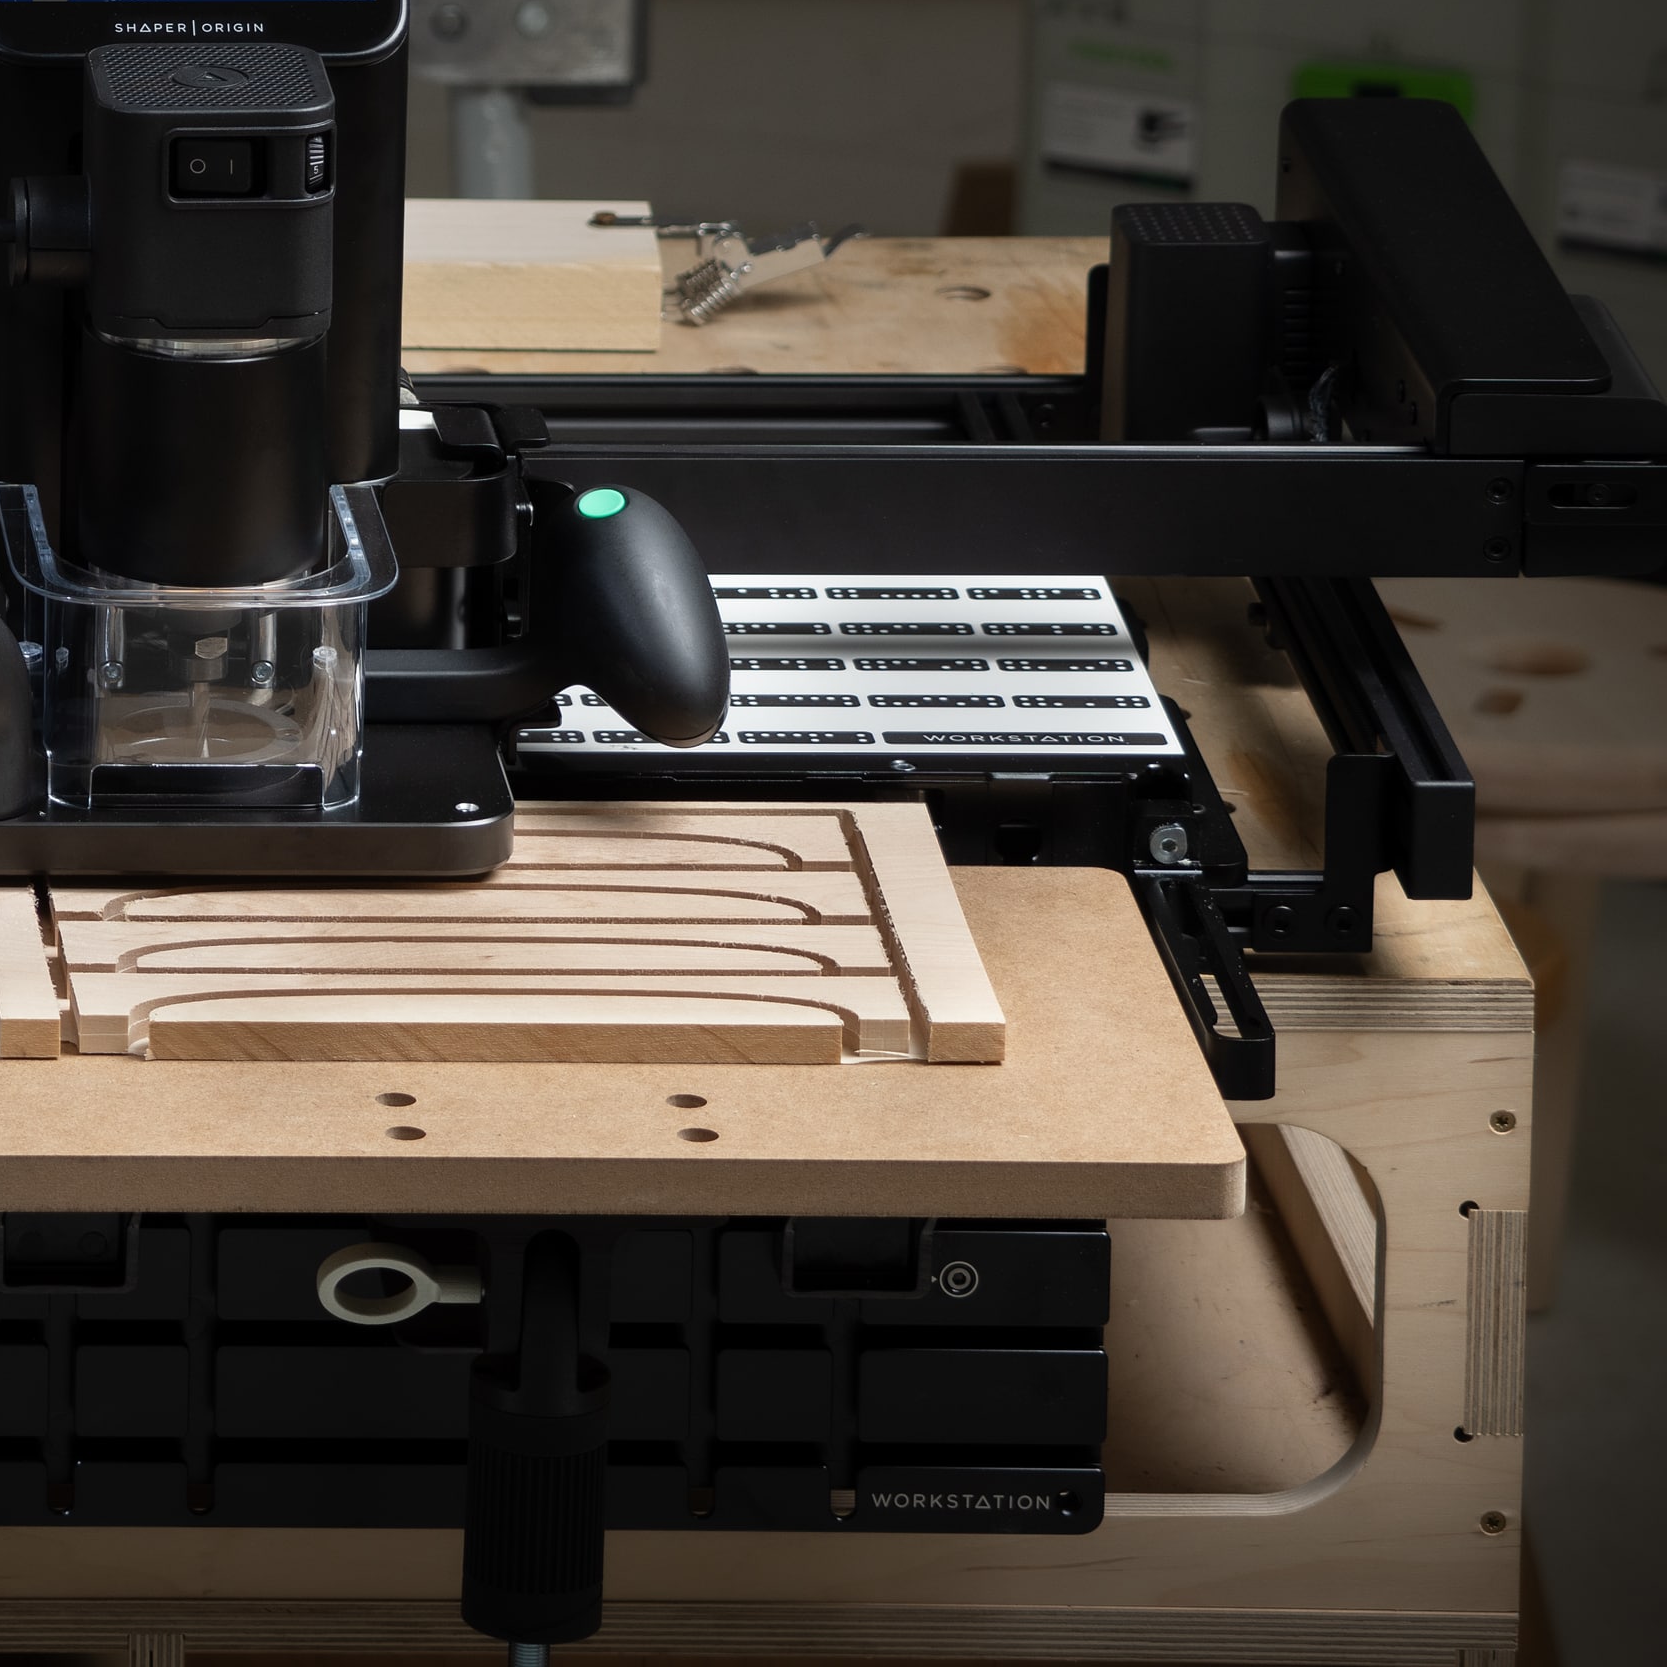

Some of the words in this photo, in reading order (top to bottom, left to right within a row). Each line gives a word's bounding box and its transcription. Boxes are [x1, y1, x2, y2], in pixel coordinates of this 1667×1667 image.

[114, 22, 187, 33] SHAPER
[201, 22, 264, 33] ORIGIN
[922, 734, 1126, 743] WORKSTATION
[871, 1493, 1051, 1510] WORKSTATION
